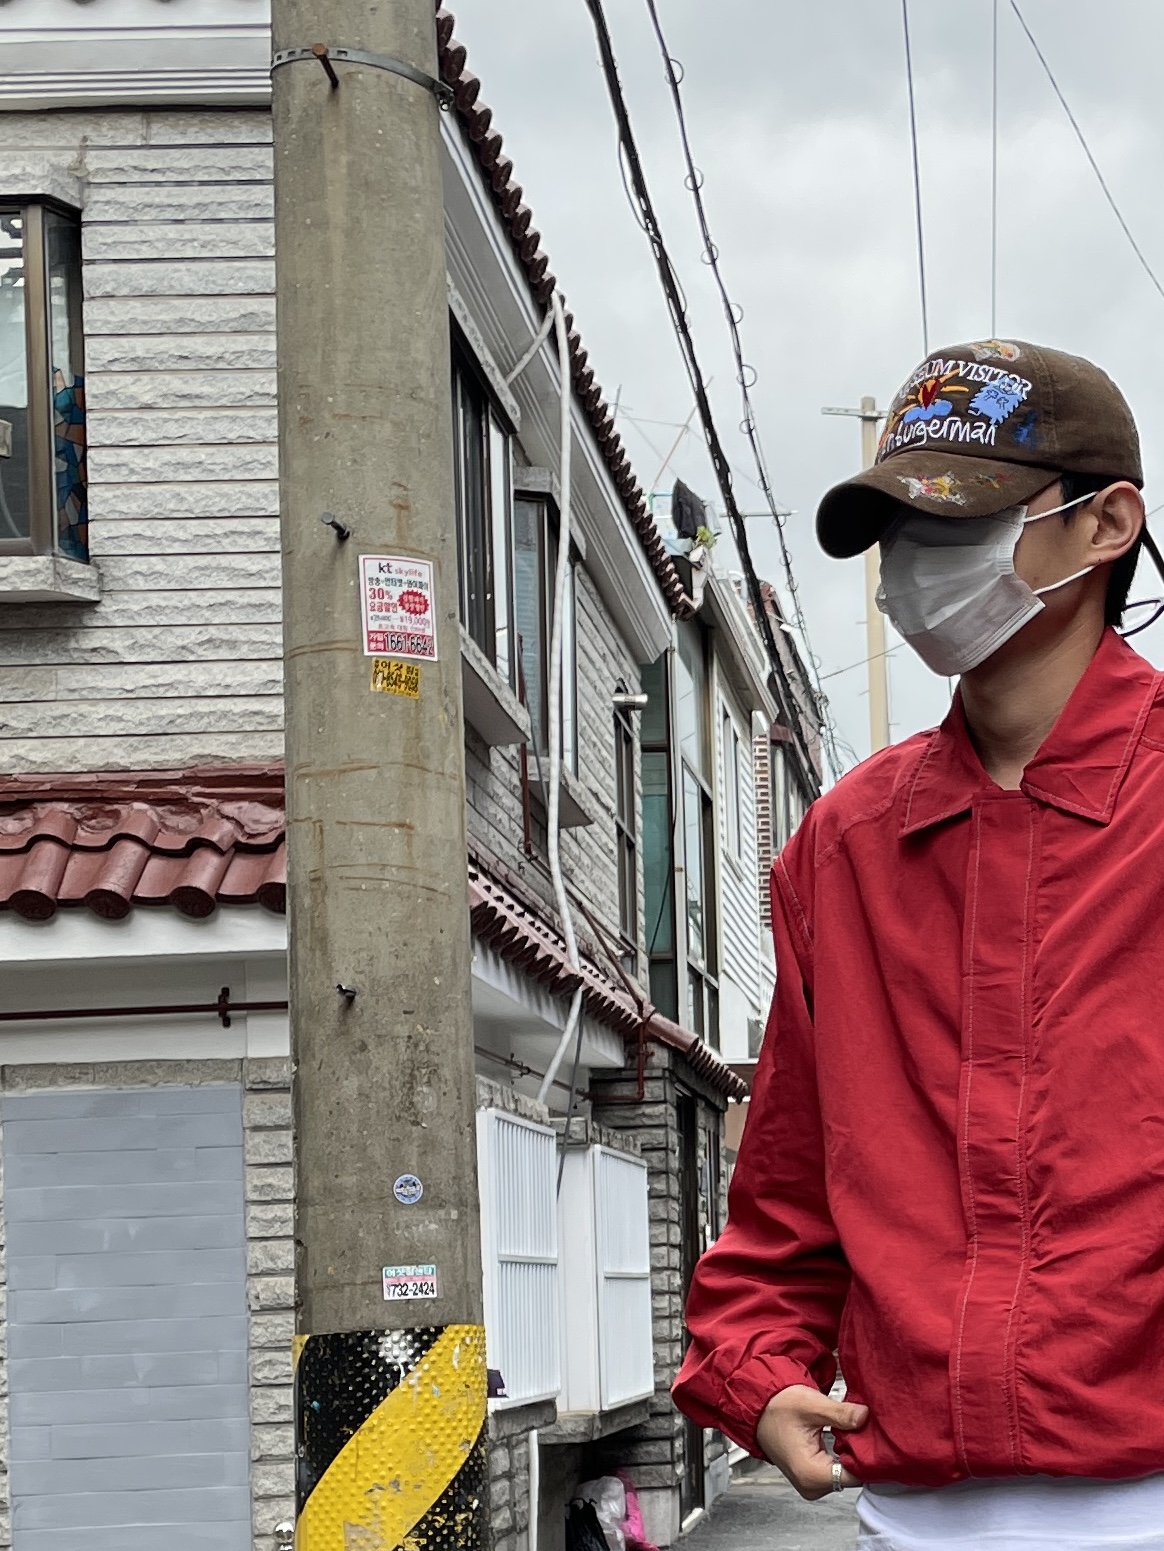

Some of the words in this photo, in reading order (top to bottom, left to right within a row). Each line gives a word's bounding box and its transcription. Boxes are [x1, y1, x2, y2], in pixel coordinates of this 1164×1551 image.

[378, 562, 393, 574] kt
[394, 568, 422, 578] skylife
[369, 588, 393, 600] 30%
